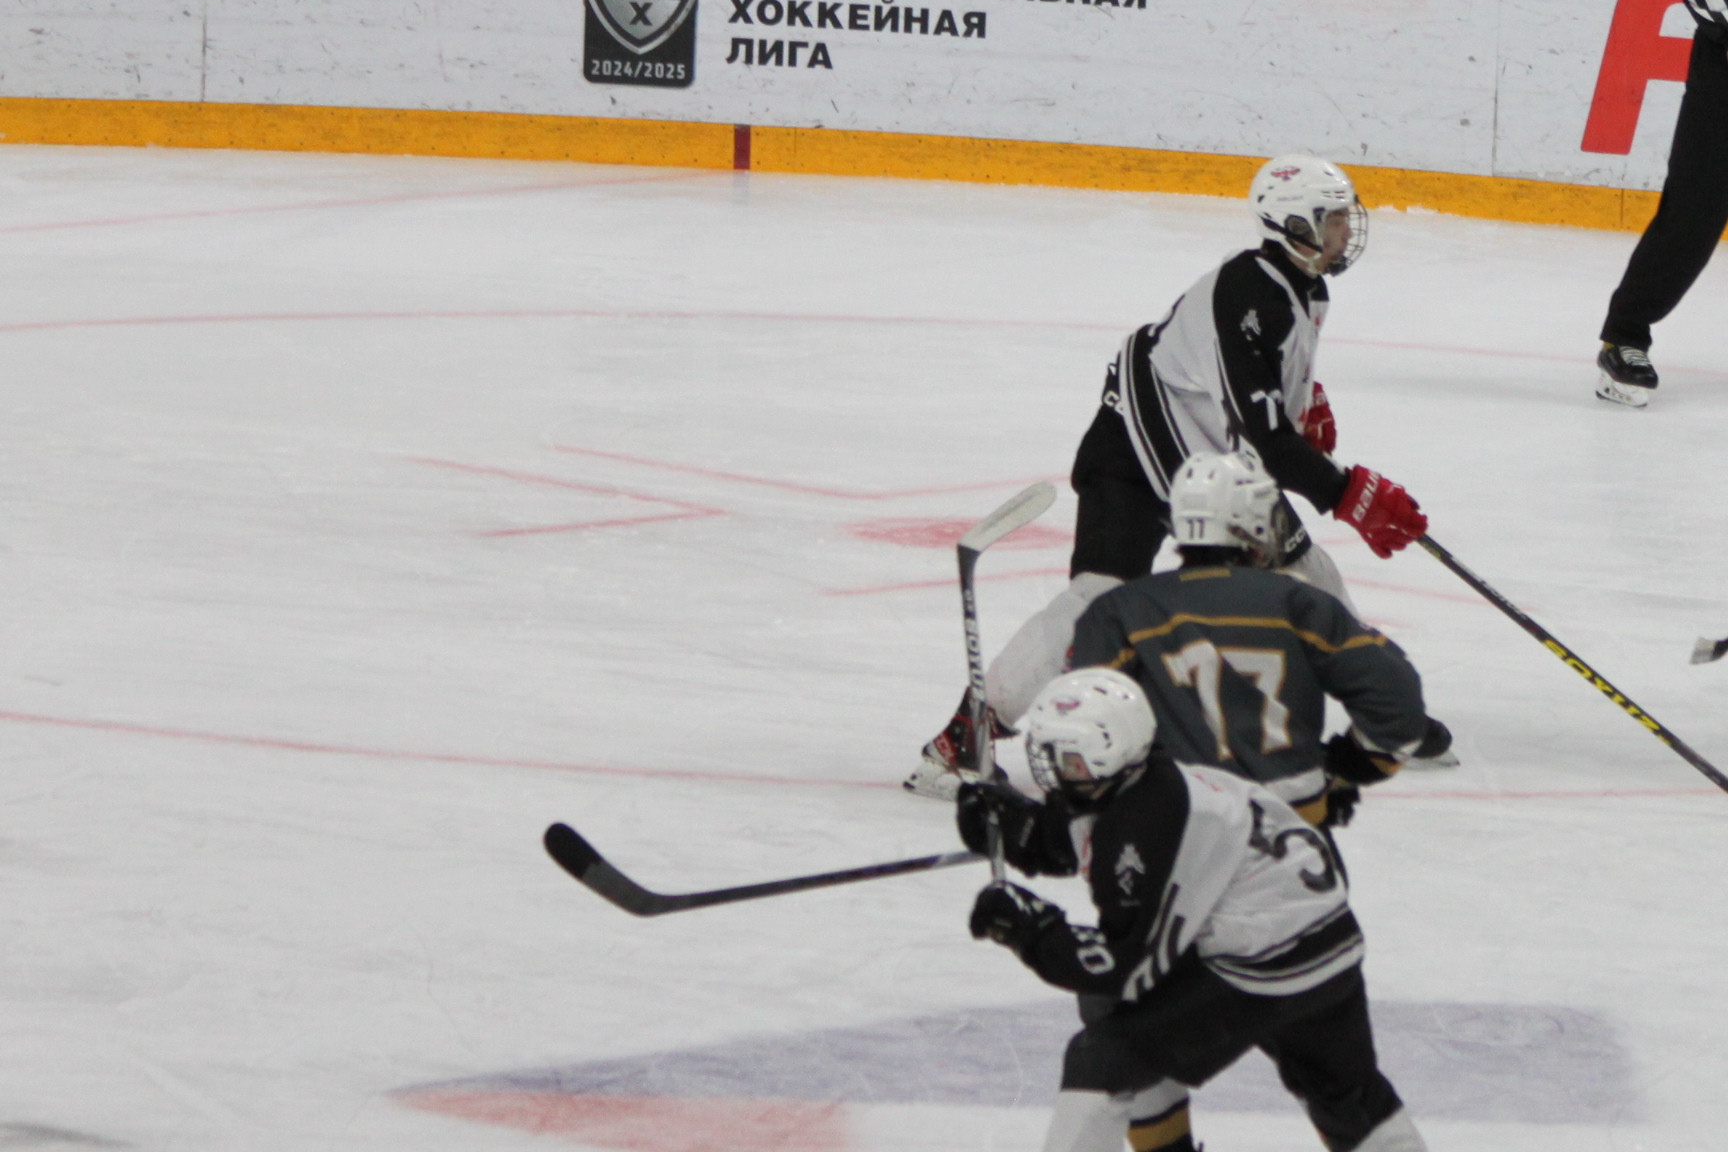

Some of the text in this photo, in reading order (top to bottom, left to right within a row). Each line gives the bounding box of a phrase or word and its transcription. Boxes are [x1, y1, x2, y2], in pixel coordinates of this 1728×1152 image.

[591, 59, 687, 80] 2024/2025
[725, 37, 833, 70] ЛИГА
[1161, 638, 1293, 760] 77
[1543, 638, 1660, 732] SOYUZ
